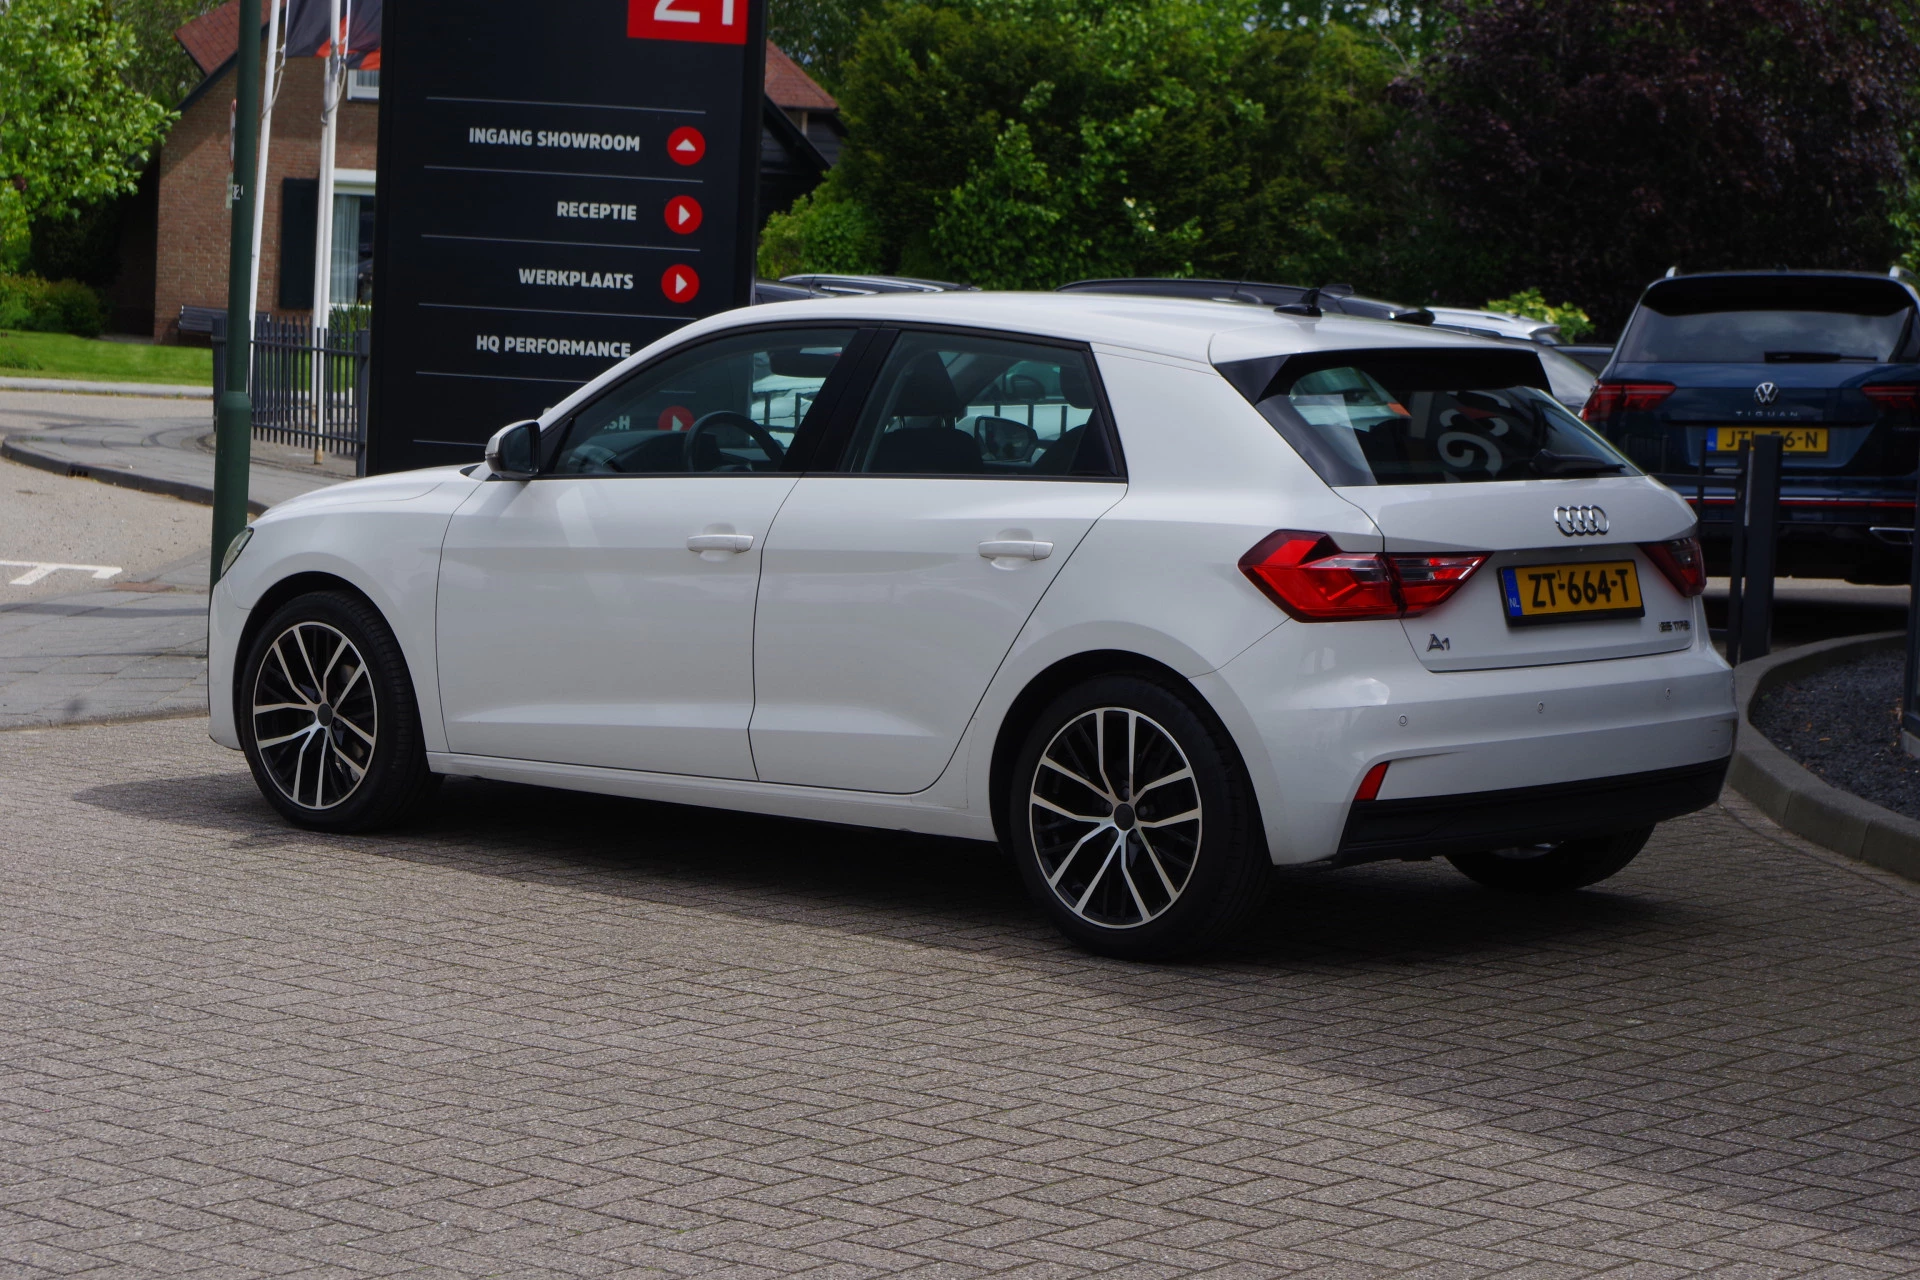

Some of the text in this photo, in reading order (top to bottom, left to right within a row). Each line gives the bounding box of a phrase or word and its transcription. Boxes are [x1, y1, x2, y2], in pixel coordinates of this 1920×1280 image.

[469, 127, 641, 152] INGANG SHOWROOM
[556, 201, 637, 220] RECEPTIE
[518, 268, 634, 289] WERKPLAATS
[476, 335, 632, 358] HQ PERFORMANCE
[1509, 568, 1630, 608] NL ZT-664-T
[1426, 633, 1450, 652] A1
